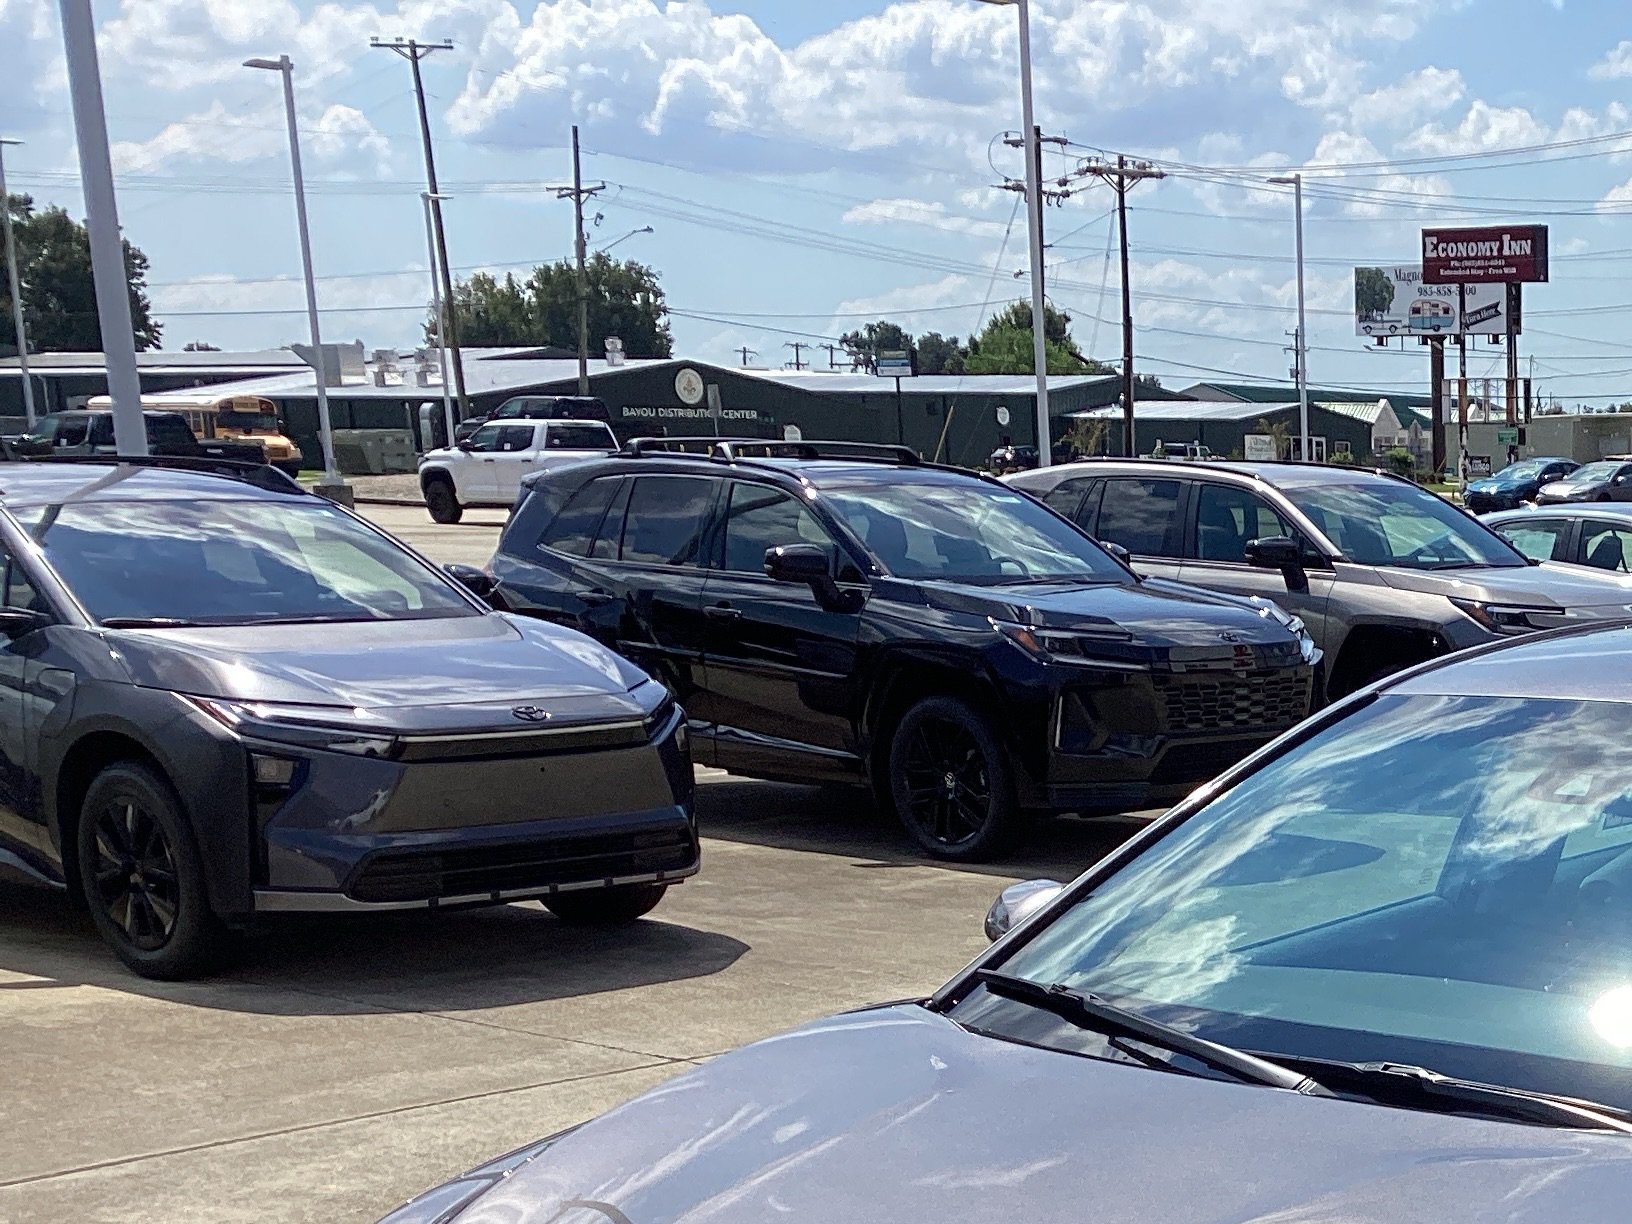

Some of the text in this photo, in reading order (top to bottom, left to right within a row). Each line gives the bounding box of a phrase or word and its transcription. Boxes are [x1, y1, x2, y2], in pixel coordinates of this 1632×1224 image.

[1394, 268, 1424, 287] Magno
[622, 406, 758, 420] BAYOU DISTRIBUTIO CENTER
